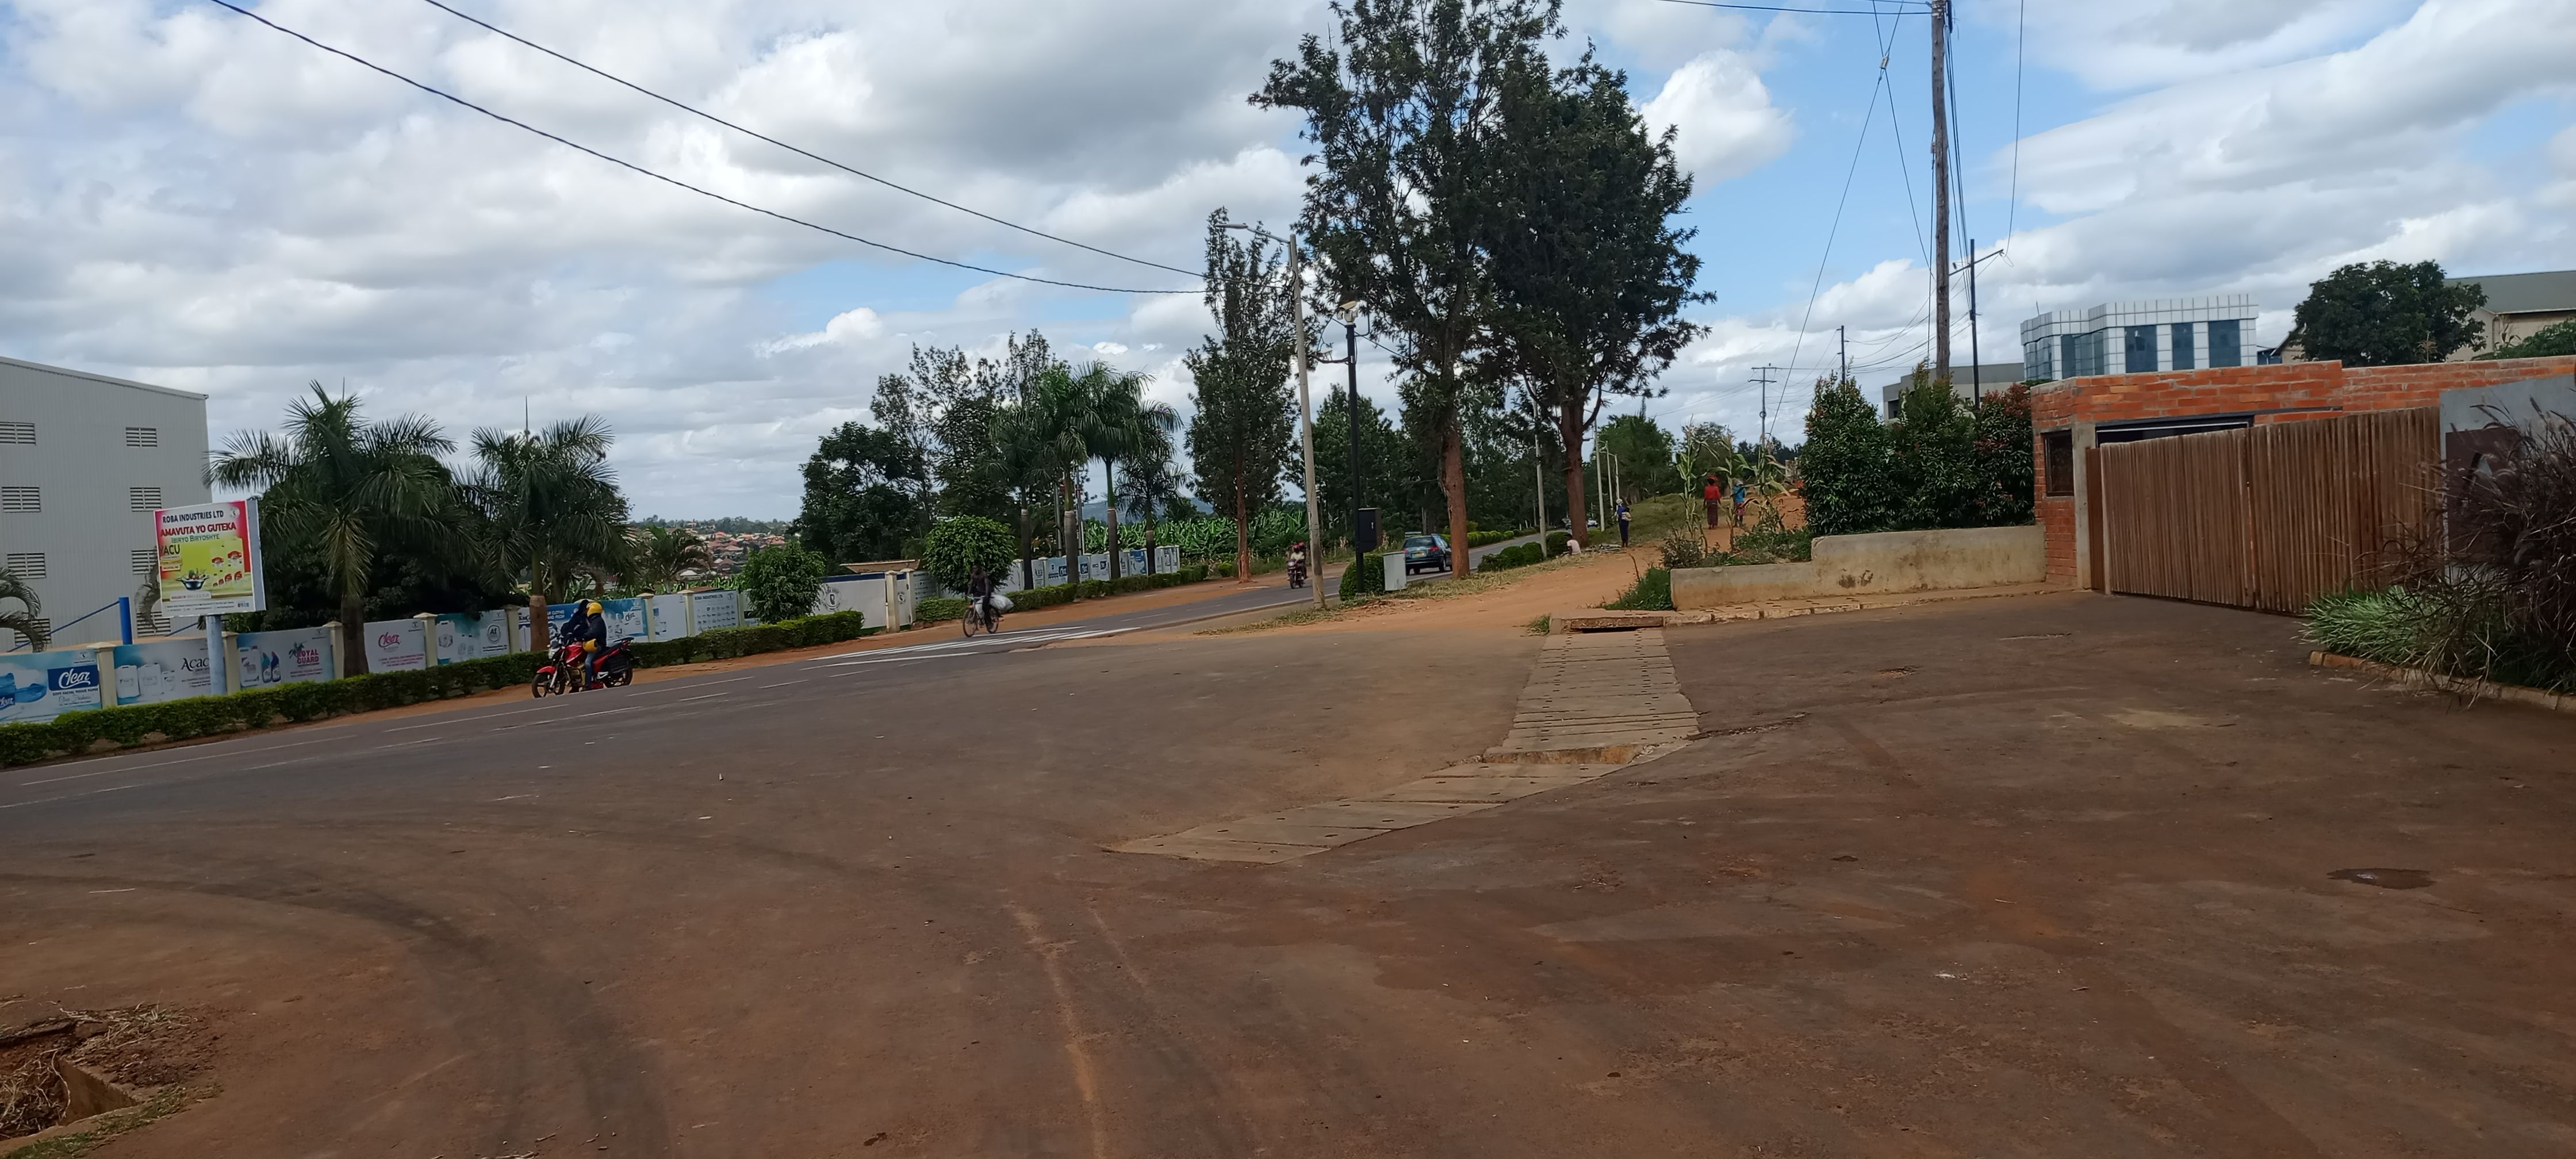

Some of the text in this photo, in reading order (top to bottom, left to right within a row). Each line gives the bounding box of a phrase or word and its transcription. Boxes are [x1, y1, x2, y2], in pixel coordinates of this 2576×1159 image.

[163, 510, 224, 523] ROBA INDUSTRIES LTD
[161, 522, 237, 537] AMAVUTA YO GUTEKA
[378, 632, 400, 648] Clear
[297, 648, 319, 658] ROYAL
[181, 658, 210, 671] Acac
[297, 656, 319, 665] GUARD
[59, 668, 91, 689] Clear
